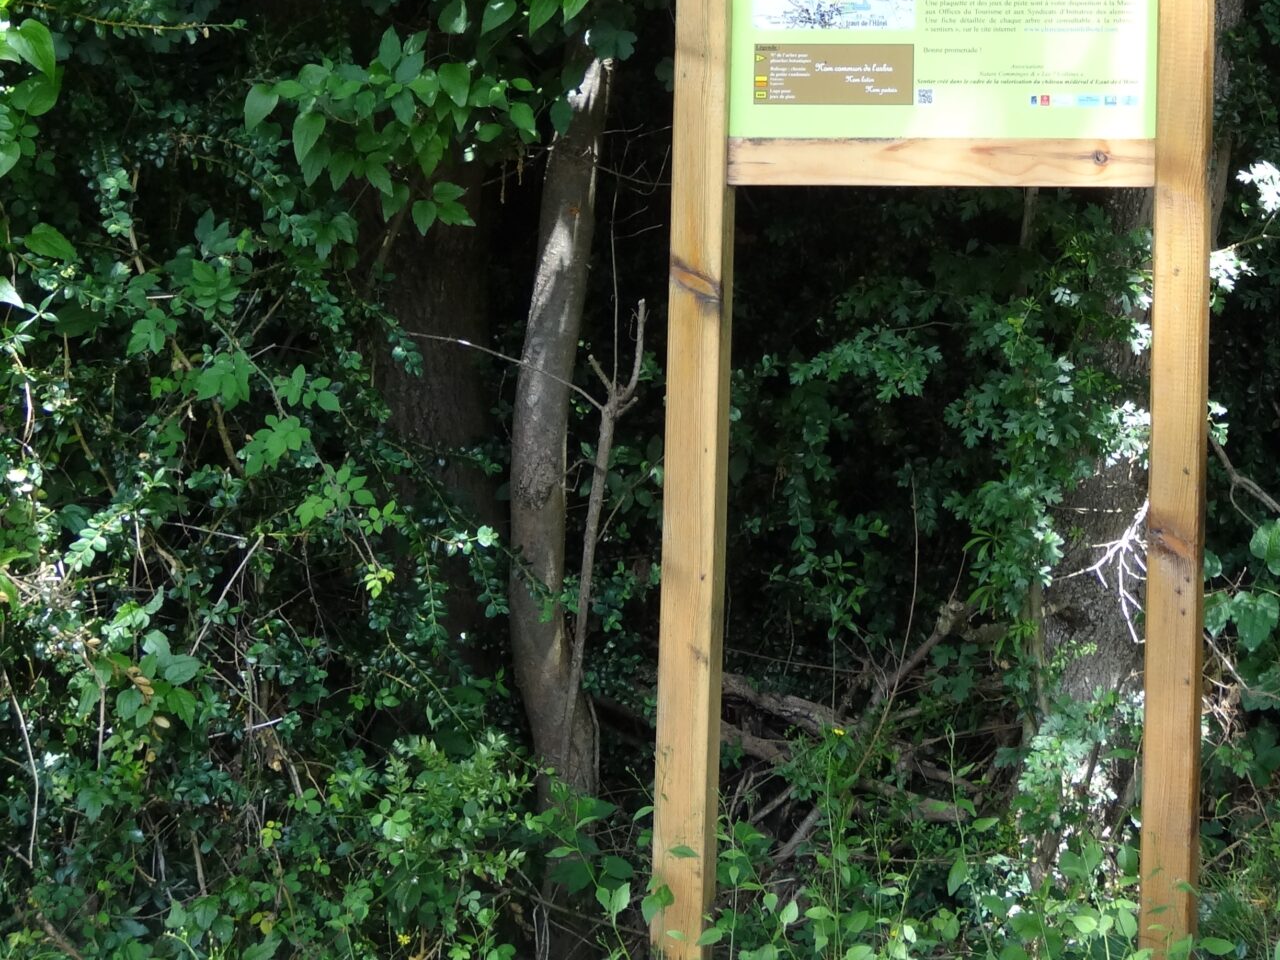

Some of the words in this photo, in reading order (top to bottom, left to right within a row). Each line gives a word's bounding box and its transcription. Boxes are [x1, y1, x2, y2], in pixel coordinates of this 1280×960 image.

[814, 63, 834, 72] Nom
[834, 63, 862, 72] commun
[863, 63, 871, 72] de
